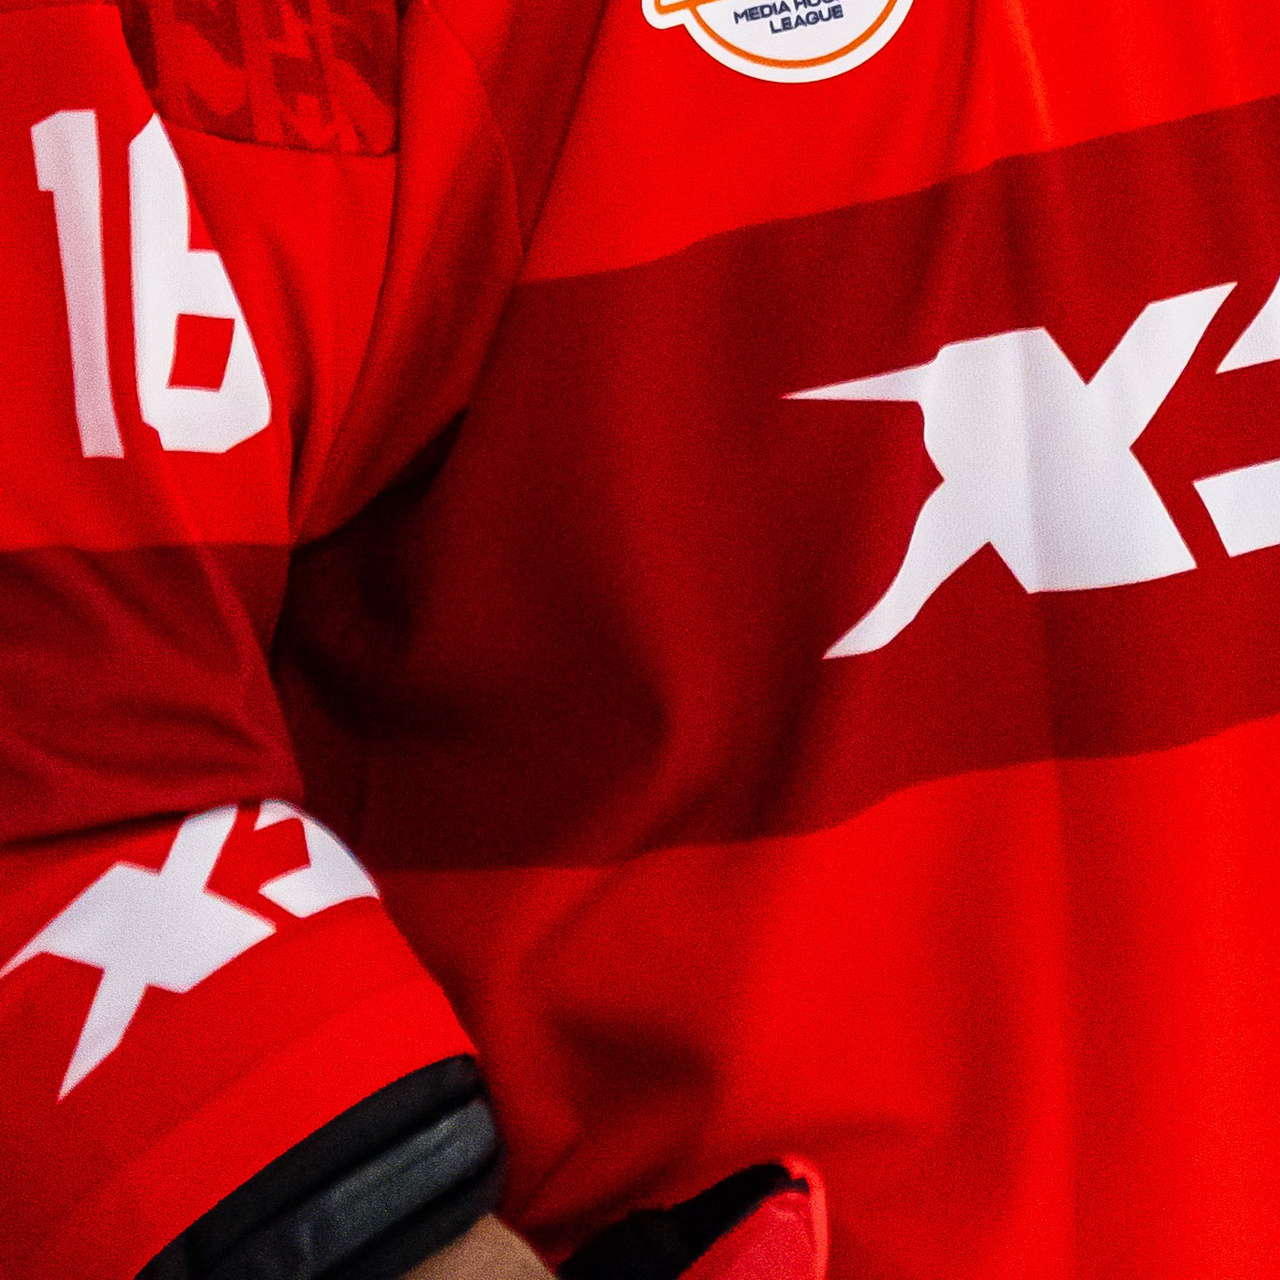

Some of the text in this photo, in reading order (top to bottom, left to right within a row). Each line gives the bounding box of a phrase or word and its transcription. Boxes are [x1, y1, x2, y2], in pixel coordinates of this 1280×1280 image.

[733, 0, 791, 24] MEDIA
[770, 5, 844, 34] LEAGUE
[31, 107, 272, 459] 16
